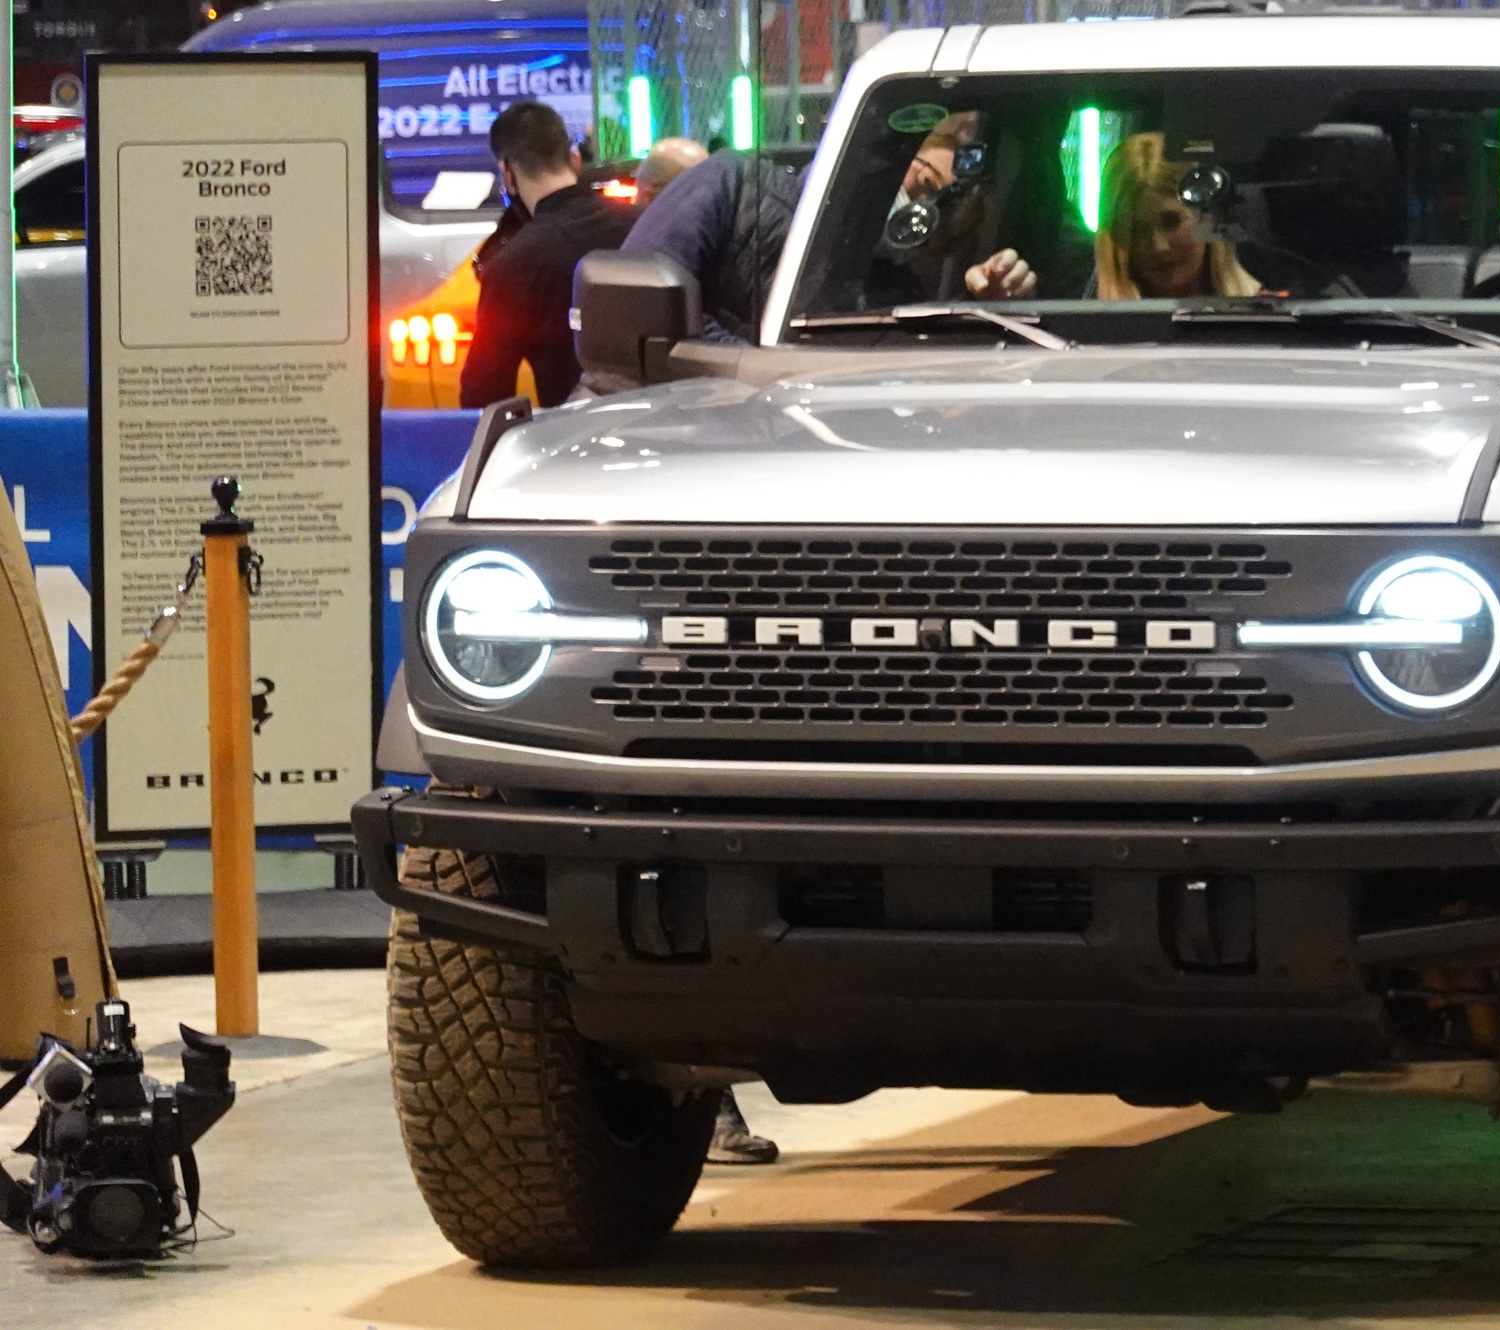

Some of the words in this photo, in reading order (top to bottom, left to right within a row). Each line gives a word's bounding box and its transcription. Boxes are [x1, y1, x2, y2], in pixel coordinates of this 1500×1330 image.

[444, 64, 489, 98] All
[378, 104, 463, 139] 2022
[182, 159, 235, 178] 2022
[240, 157, 286, 176] Ford
[199, 180, 271, 198] Bronco
[661, 616, 1216, 650] BRONCO
[146, 768, 338, 789] BRNCO
